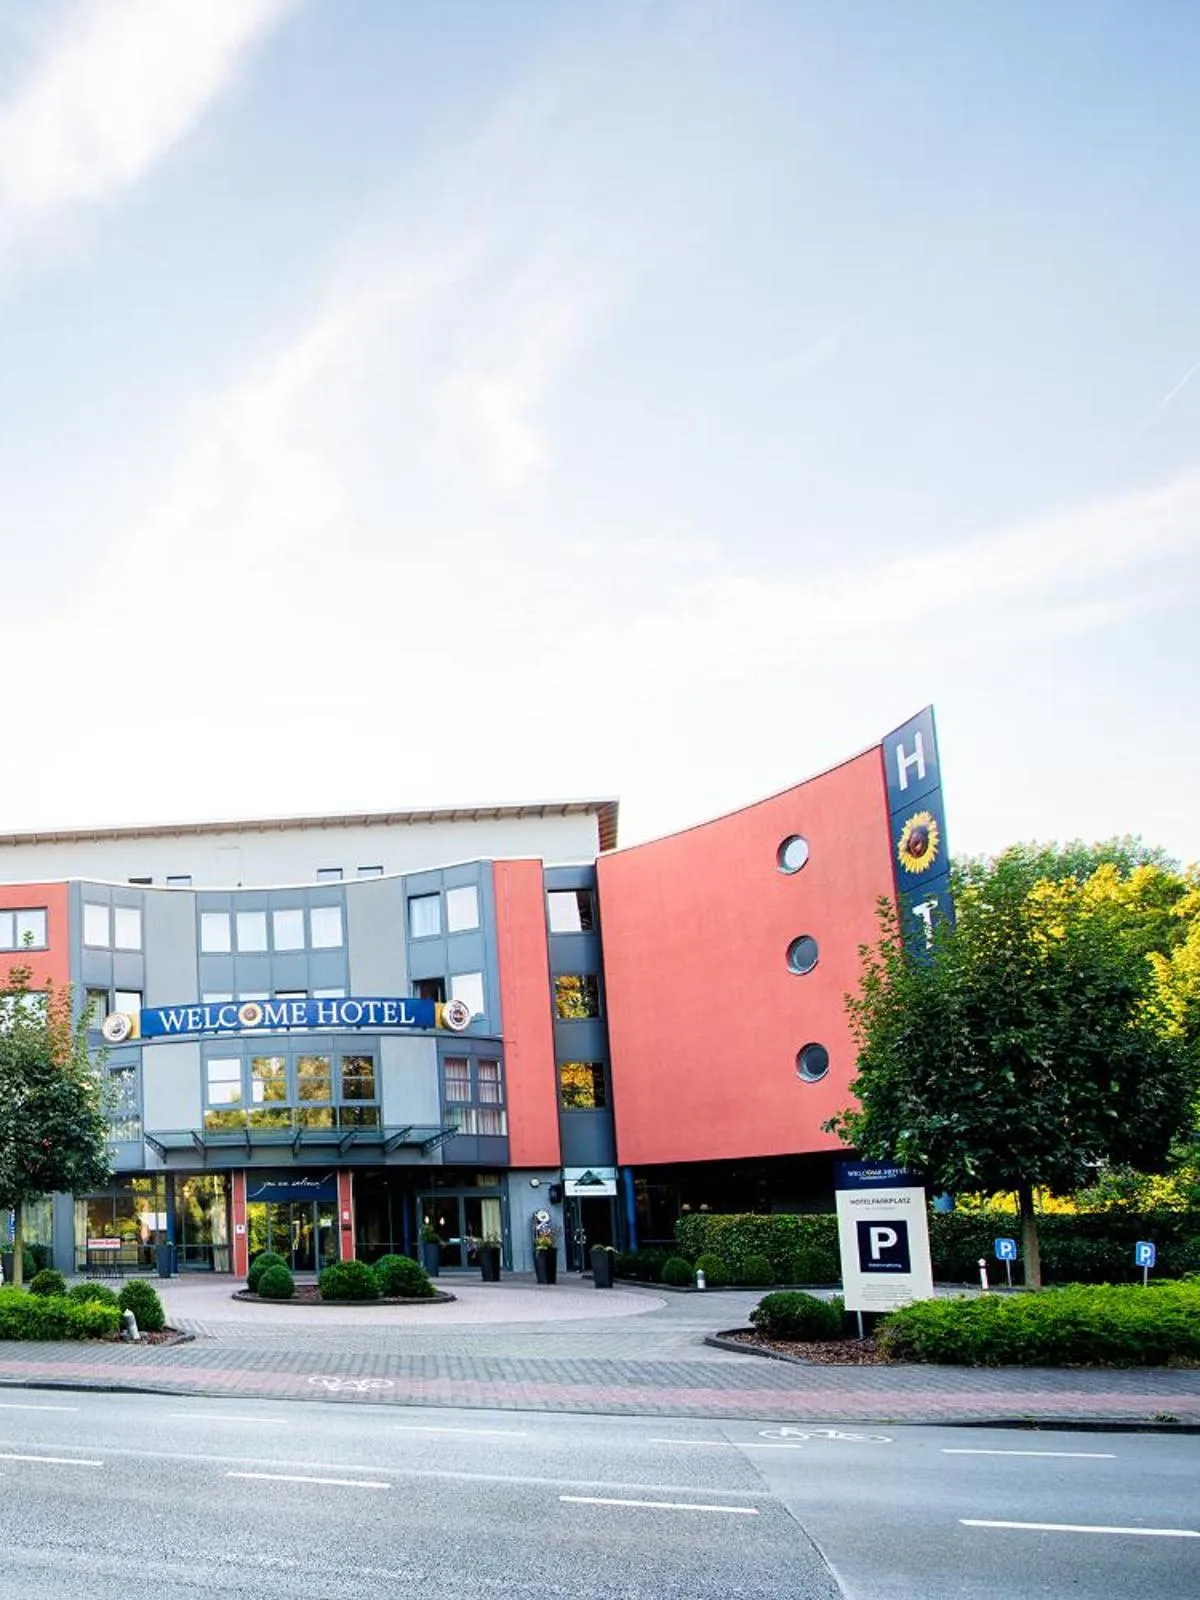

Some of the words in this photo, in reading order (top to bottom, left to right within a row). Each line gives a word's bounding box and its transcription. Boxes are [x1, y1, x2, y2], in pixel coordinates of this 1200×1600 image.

[159, 1002, 307, 1032] WELCOME
[317, 1001, 415, 1024] HOTEL
[870, 1227, 898, 1259] P
